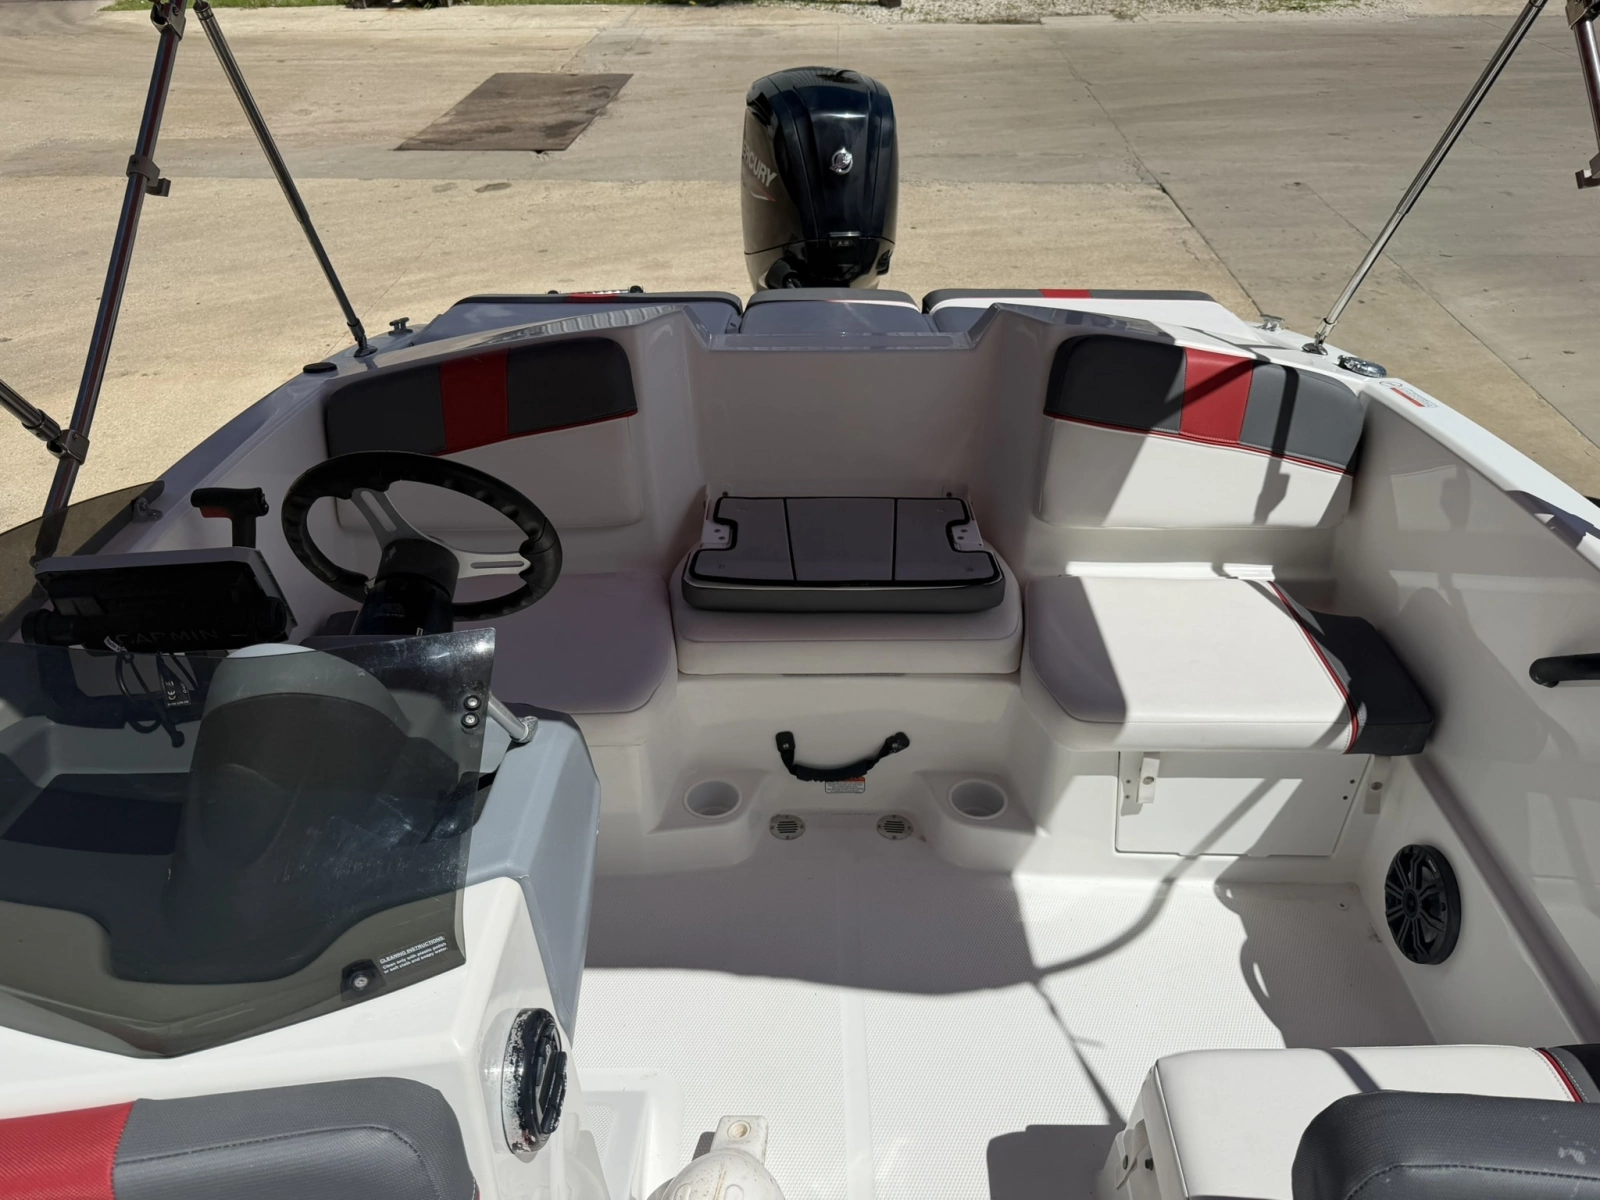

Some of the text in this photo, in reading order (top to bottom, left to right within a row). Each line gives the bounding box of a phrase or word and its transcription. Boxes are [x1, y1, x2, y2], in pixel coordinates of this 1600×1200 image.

[741, 143, 777, 187] ERCURY
[380, 950, 407, 964] CLEANING
[382, 962, 396, 970] Clean
